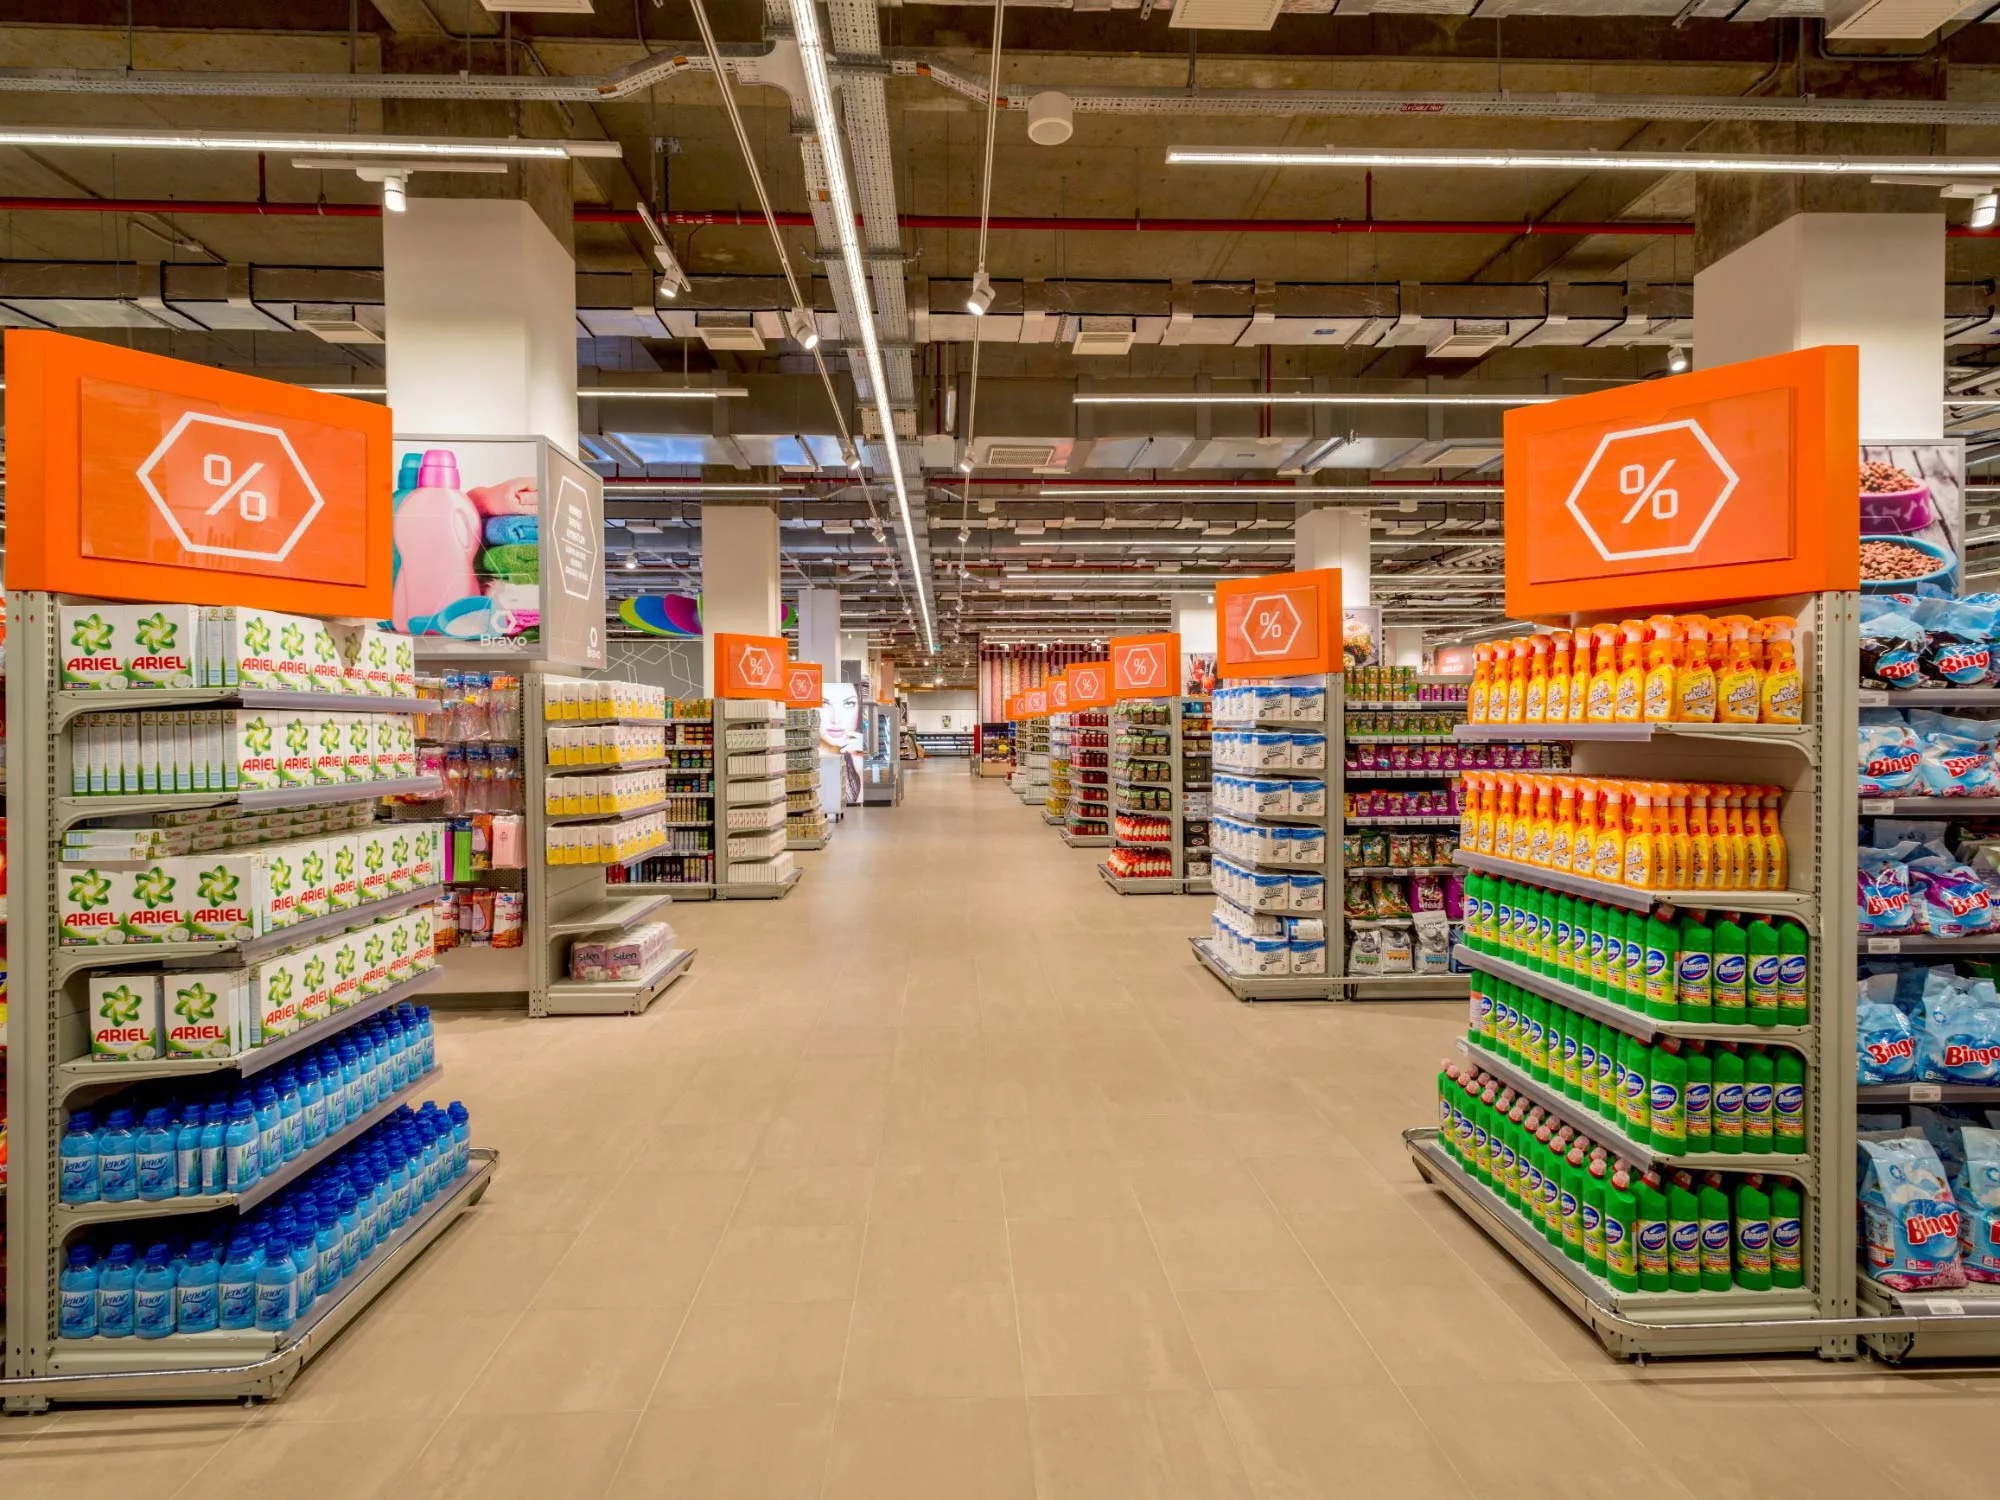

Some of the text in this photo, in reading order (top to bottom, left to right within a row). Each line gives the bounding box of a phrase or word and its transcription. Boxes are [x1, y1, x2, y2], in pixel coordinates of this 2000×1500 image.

[203, 454, 266, 522] %
[1620, 458, 1679, 524] %
[1259, 611, 1282, 640] %
[480, 633, 527, 647] Bravo
[66, 657, 123, 671] ARIEL
[131, 656, 188, 670] ARIEL
[242, 658, 276, 672] ARIEL
[278, 661, 309, 675] ARIEL
[750, 657, 764, 676] %
[1133, 658, 1148, 675] %
[1879, 661, 1918, 678] Bin
[1937, 651, 1989, 673] Bing
[314, 664, 341, 677] ARIEL
[242, 757, 277, 772] ARIEL
[284, 757, 312, 769] ARIEL
[318, 755, 344, 767] ARIEL
[1867, 753, 1920, 777] Bingo
[300, 888, 328, 904] ARIEL
[64, 912, 120, 927] ARIEL
[129, 910, 184, 925] ARIEL
[193, 908, 247, 922] ARIEL
[362, 967, 388, 984] ARIEL
[333, 978, 359, 996] ARIEL
[301, 988, 328, 1009] ARIEL
[265, 1004, 297, 1026] ARIEL
[96, 1028, 150, 1042] ARIEL
[170, 1026, 225, 1040] ARIEL
